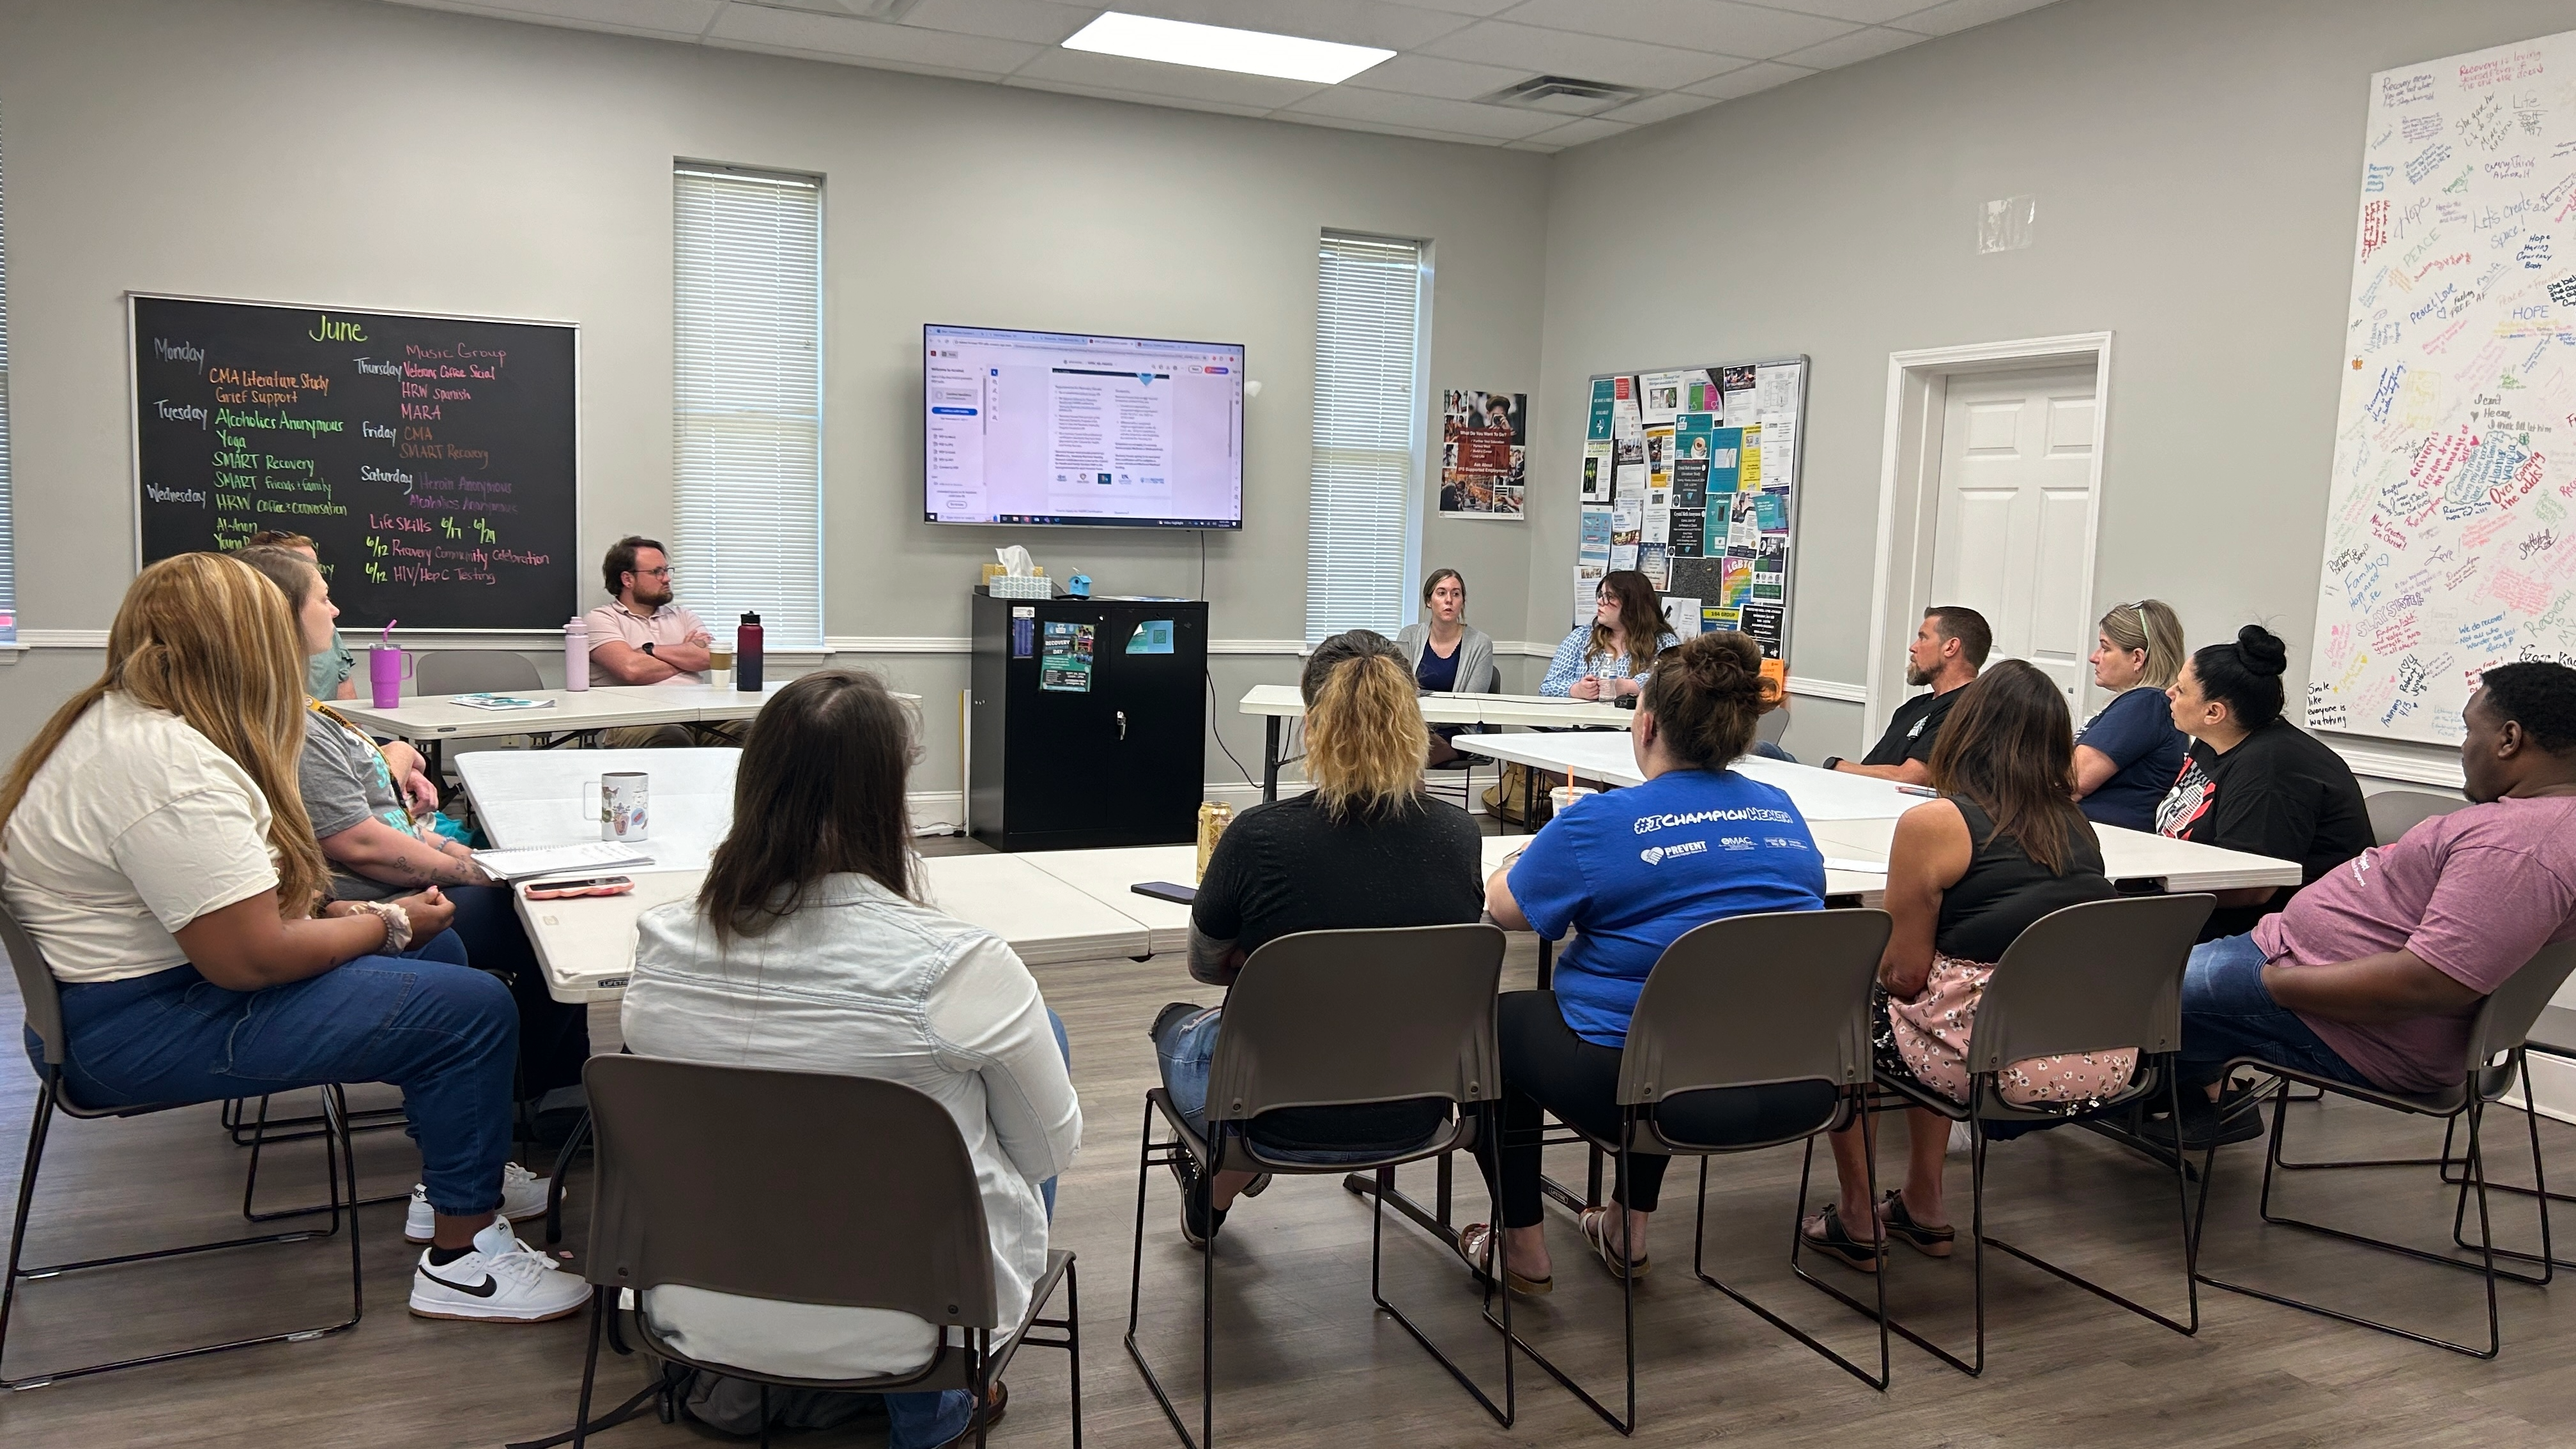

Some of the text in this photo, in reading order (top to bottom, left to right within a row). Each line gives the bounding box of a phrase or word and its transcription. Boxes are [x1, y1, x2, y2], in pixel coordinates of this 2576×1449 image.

[2460, 51, 2541, 75] Recovery loving
[2382, 77, 2411, 93] Recovery
[2513, 89, 2540, 109] Life
[2456, 118, 2471, 135] She
[2403, 227, 2441, 268] PEACE
[2529, 233, 2550, 243] Hope
[2410, 282, 2457, 325] Peace Love
[2513, 305, 2549, 319] HOPE
[309, 315, 368, 341] June
[154, 337, 204, 374] Monday
[406, 342, 506, 367] Music Group
[353, 357, 402, 381] Thursday
[440, 366, 466, 379] Coffee
[470, 364, 494, 379] Social
[209, 368, 328, 396] CMA Literature Study
[402, 381, 427, 398] HRW
[216, 387, 297, 408] Grief Support
[154, 399, 207, 430] Tuesday
[401, 404, 441, 420] MARA
[2484, 408, 2495, 418] He
[215, 408, 343, 438] Alcoholics Anonymous
[404, 426, 433, 441] CMA
[2497, 420, 2552, 433] think let him
[217, 430, 246, 453] Yoga
[363, 421, 396, 447] Friday
[212, 452, 314, 477] SMART Recovery
[399, 444, 488, 470] SMART Recovery
[2440, 438, 2467, 471] bondage
[214, 471, 257, 490] SMART
[361, 465, 413, 495] Saturday
[420, 473, 512, 500] Heroin Anonymous
[2500, 463, 2543, 511] the odds!
[146, 482, 206, 509] Wednesday
[216, 493, 251, 510] HRW
[2490, 482, 2514, 504] Over
[410, 494, 518, 514] Alcoholics Anonymous
[2442, 505, 2473, 515] Recovery
[217, 518, 257, 534] Al-Anon
[370, 513, 394, 530] Life
[397, 518, 432, 533] Skills
[441, 516, 461, 539] 6/17
[2370, 513, 2384, 528] New
[366, 536, 549, 570] 6/12 Recovery Community Celebration
[2424, 545, 2454, 566] Love
[365, 562, 387, 583] 6/12
[454, 567, 496, 585] Testing
[2345, 562, 2377, 595] Family
[2349, 572, 2379, 612] Happiness
[2363, 591, 2381, 614] Life
[2356, 606, 2388, 637] SLAY
[2376, 625, 2400, 639] Finding
[2459, 624, 2470, 634] We
[2481, 611, 2506, 626] recover!
[2485, 627, 2499, 636] who
[2372, 636, 2384, 647] and
[2386, 631, 2403, 641] value
[2407, 631, 2421, 640] AND
[2399, 667, 2418, 693] Robert
[2465, 667, 2483, 678] Being
[2308, 682, 2329, 695] Smile
[2307, 705, 2337, 716] everyone
[2308, 696, 2322, 707] like
[2308, 716, 2347, 728] watching
[1664, 841, 1706, 856] PREVENT
